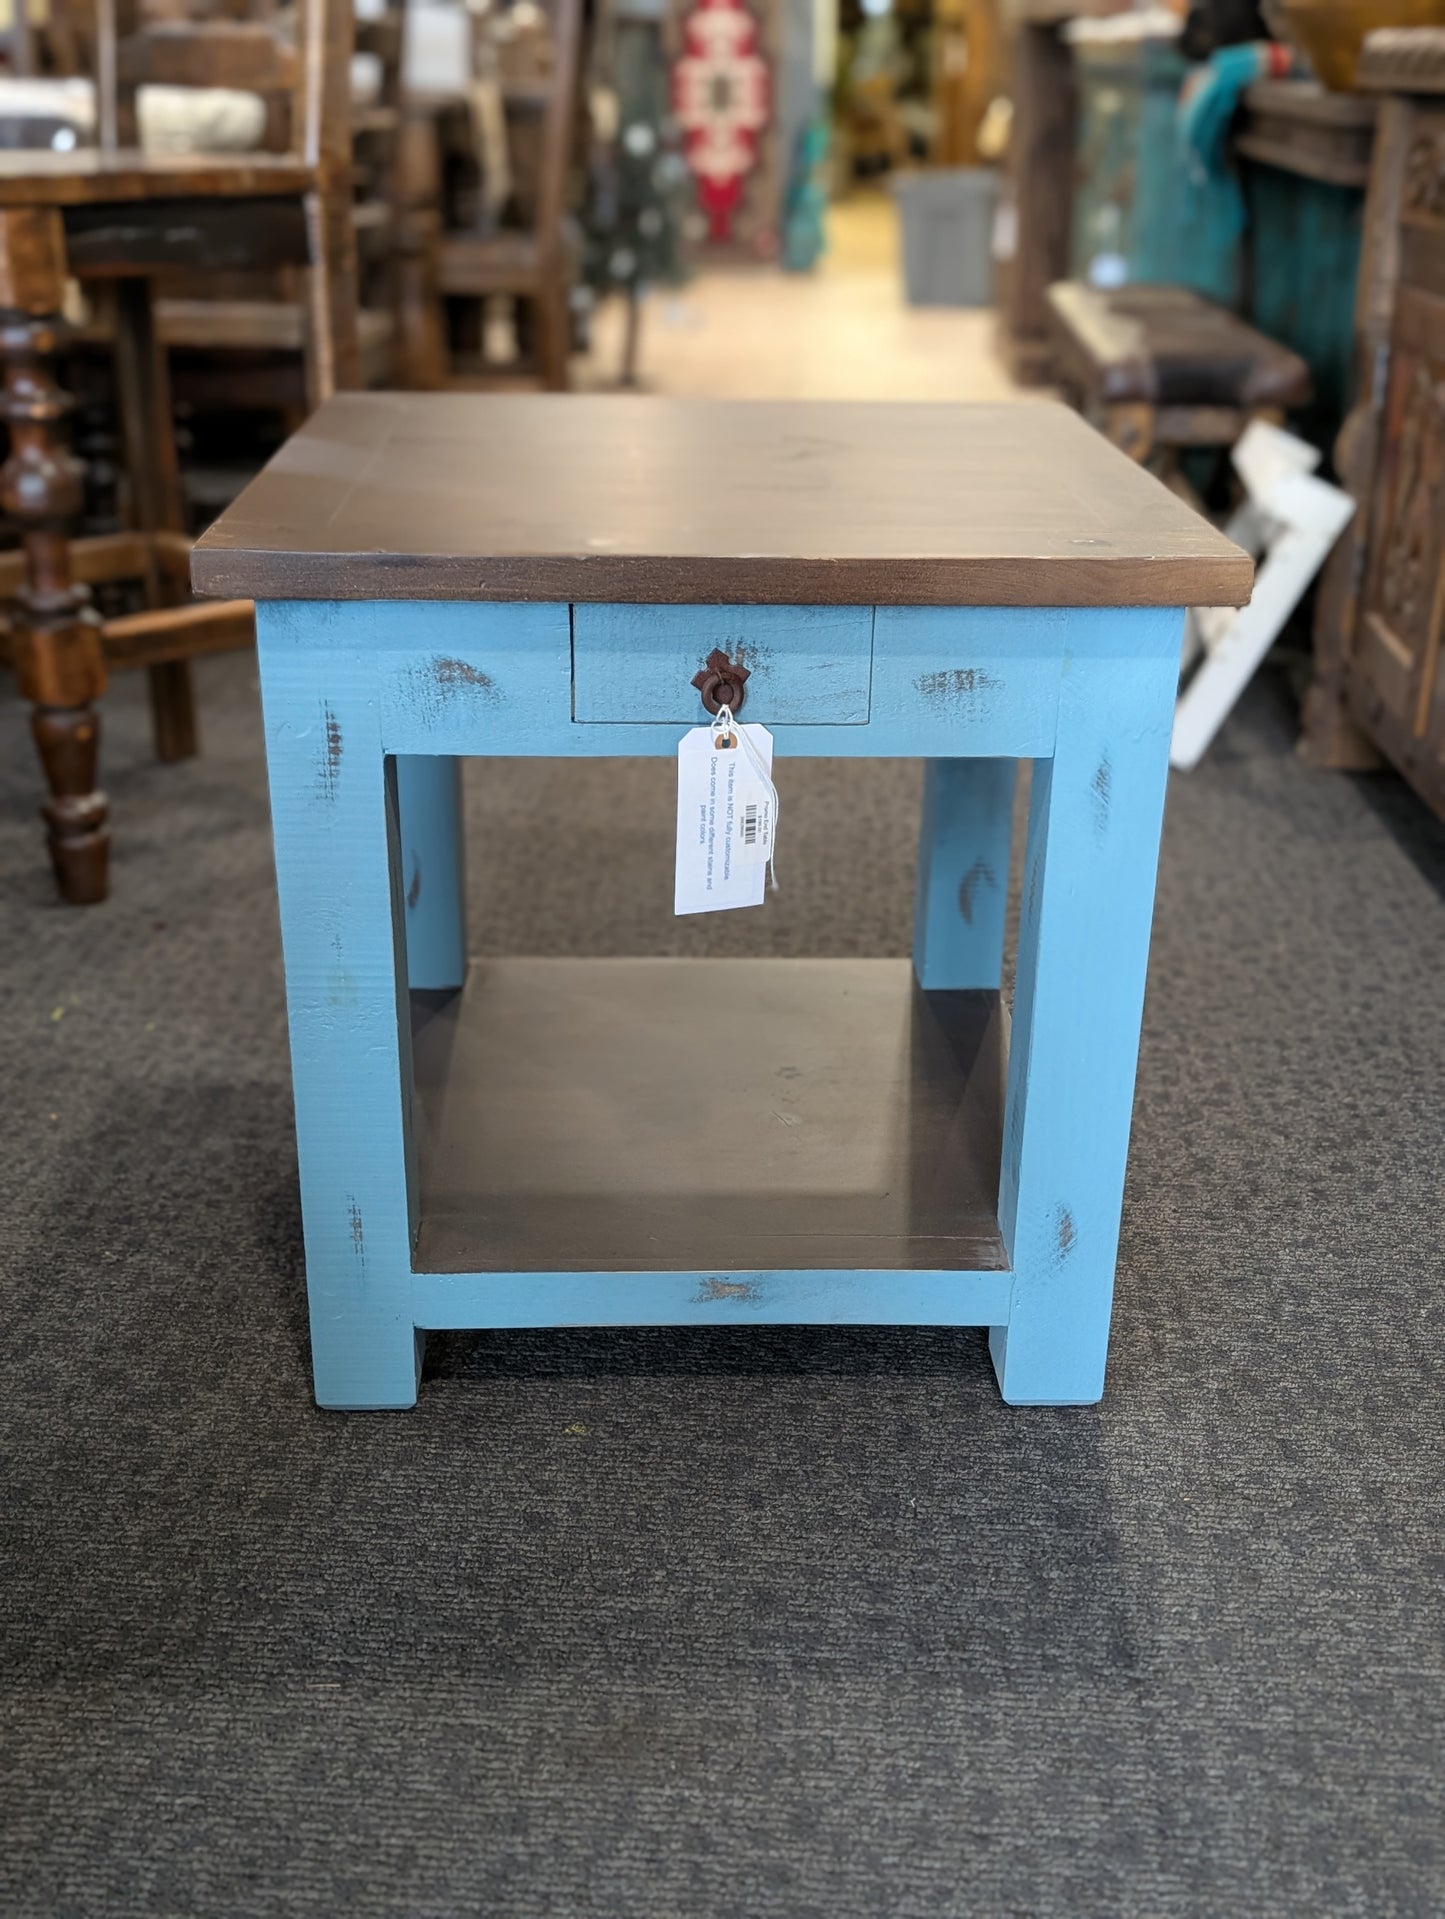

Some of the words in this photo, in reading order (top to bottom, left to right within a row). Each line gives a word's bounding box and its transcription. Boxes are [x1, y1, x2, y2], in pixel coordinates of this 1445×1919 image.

[710, 756, 718, 776] Does
[728, 762, 736, 778] This
[710, 798, 716, 806] in
[726, 803, 734, 820] NOT
[724, 821, 733, 835] fully
[708, 826, 716, 855] different
